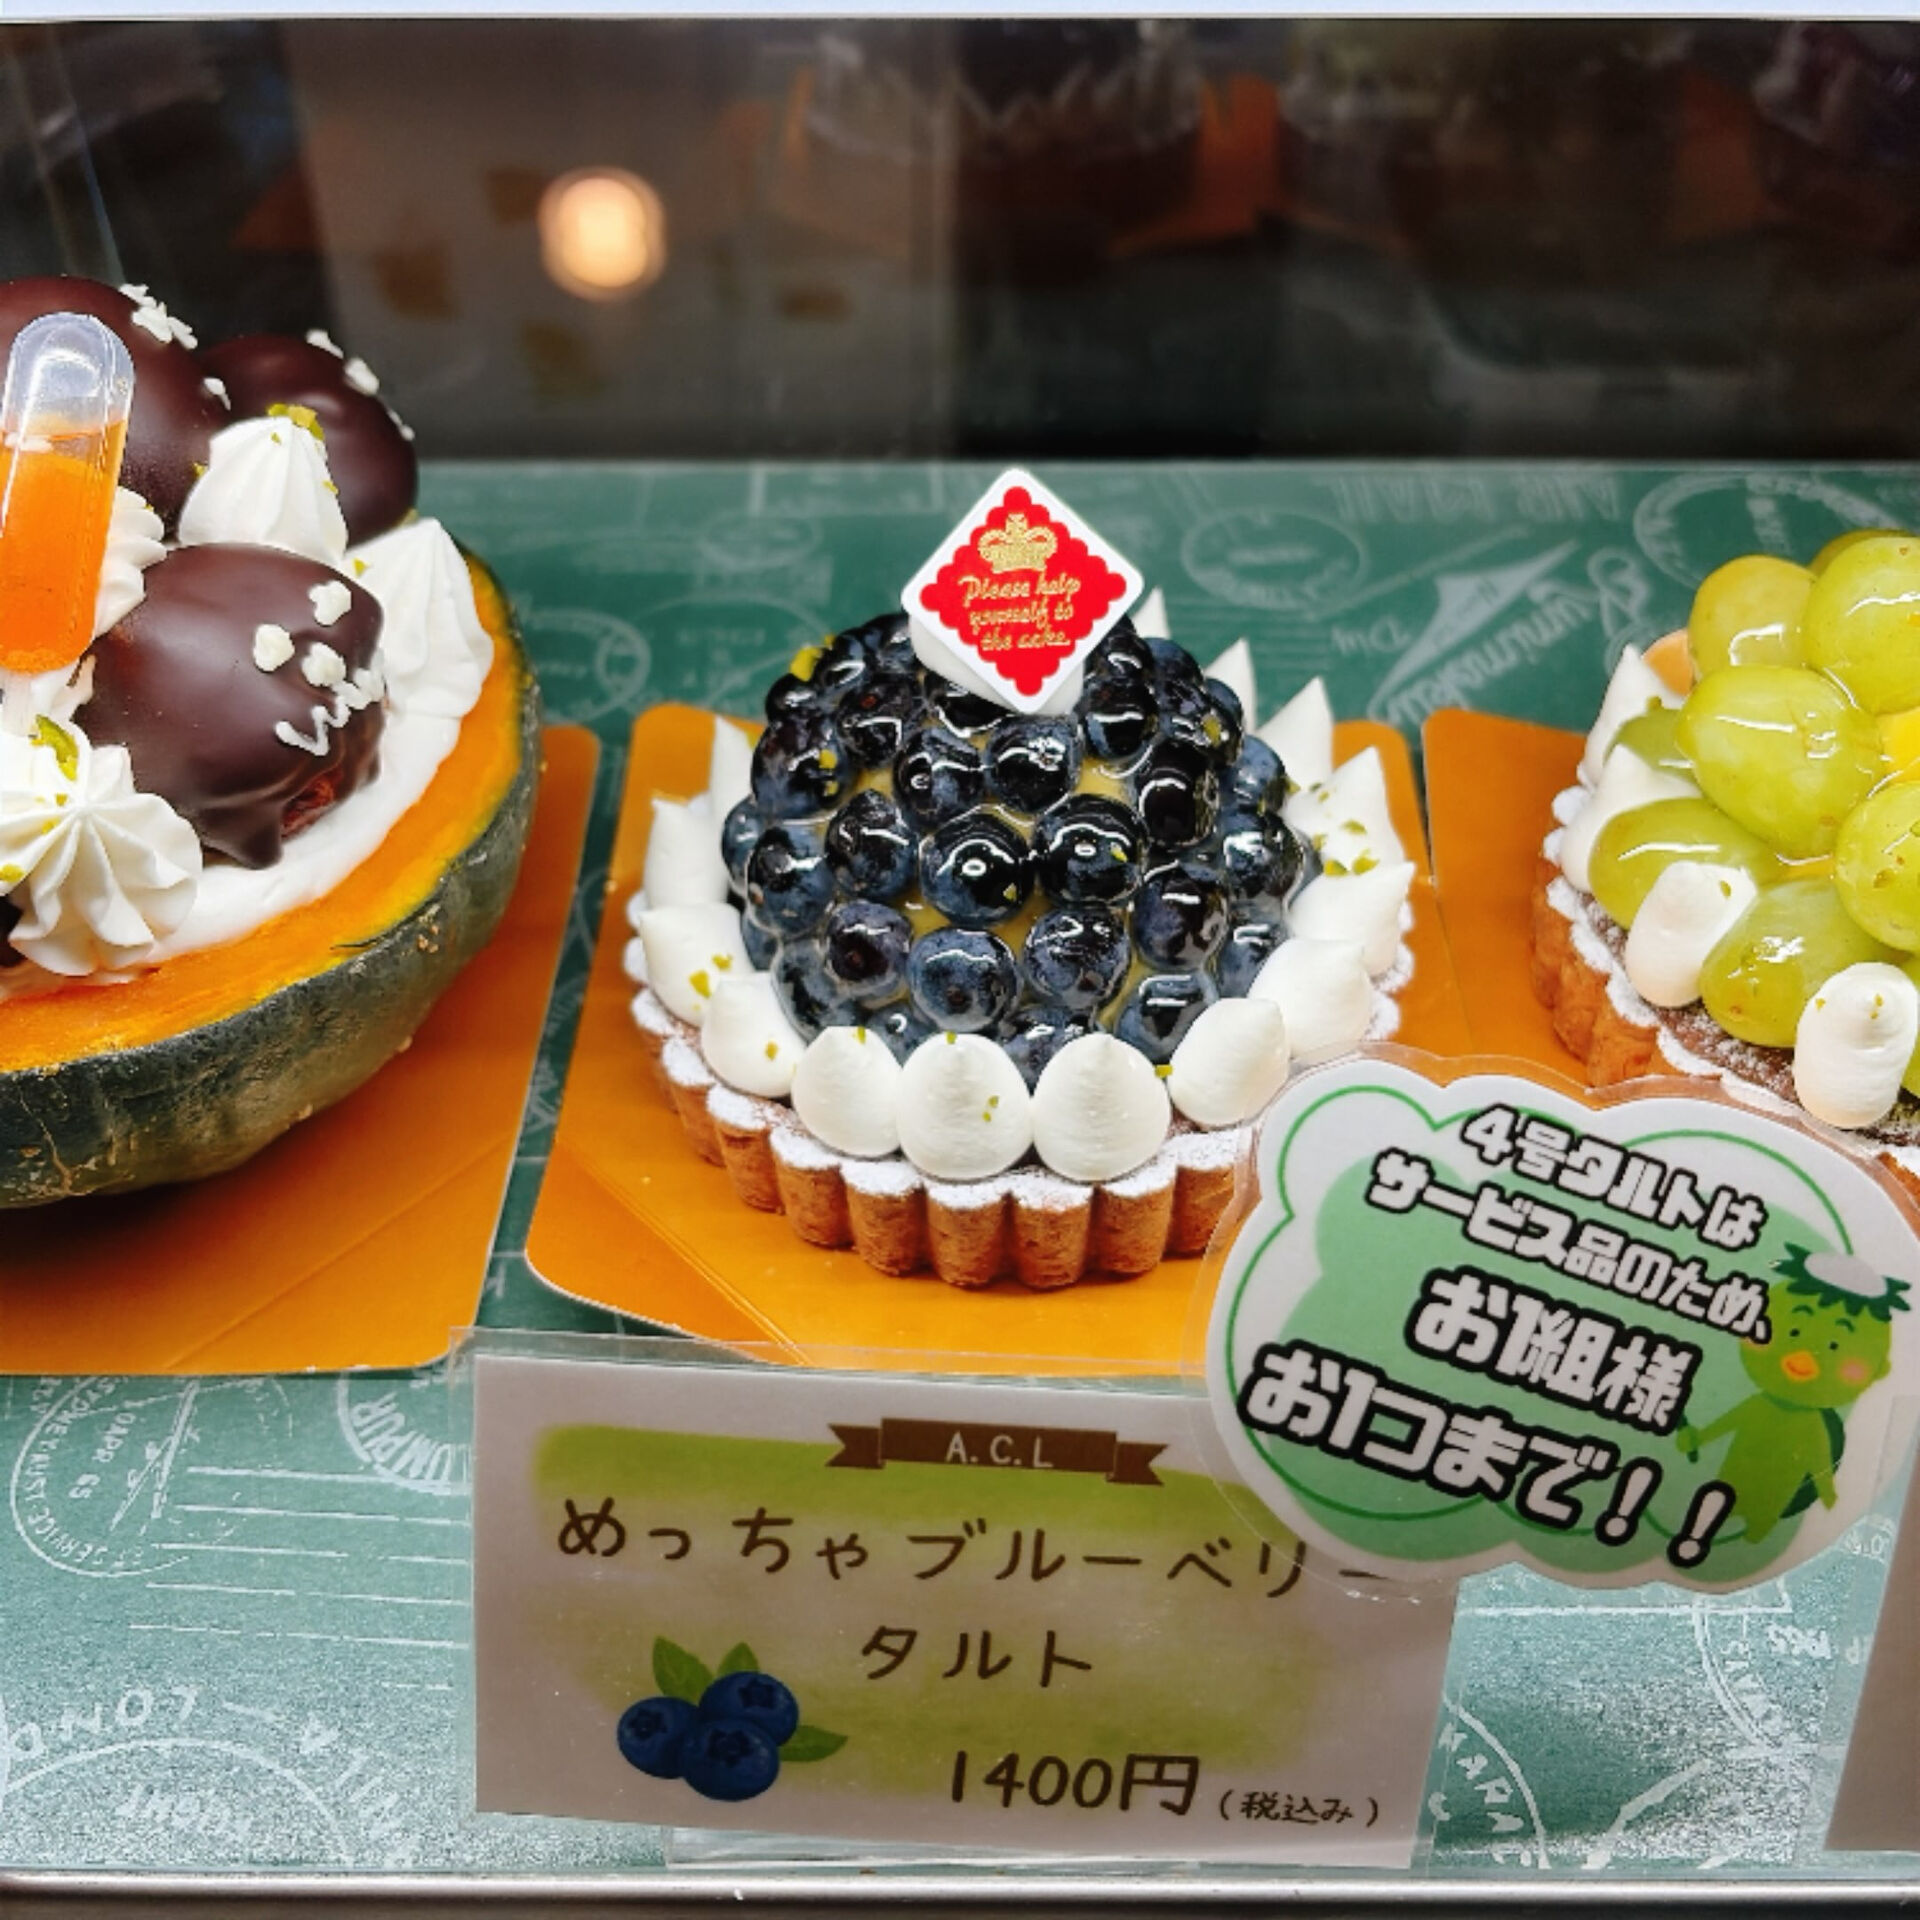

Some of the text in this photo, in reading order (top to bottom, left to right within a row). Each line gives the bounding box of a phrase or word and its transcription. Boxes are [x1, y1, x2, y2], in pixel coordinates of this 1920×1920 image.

[958, 570, 1081, 607] Please help
[969, 598, 1074, 635] yourself to
[981, 626, 1012, 651] the
[1461, 1103, 1766, 1251] 4号タルトは
[1365, 1147, 1773, 1343] サービス品のため、
[1405, 1266, 1701, 1436] お1組様
[859, 1625, 1092, 1688] タルト
[952, 1750, 1200, 1815] 1400円
